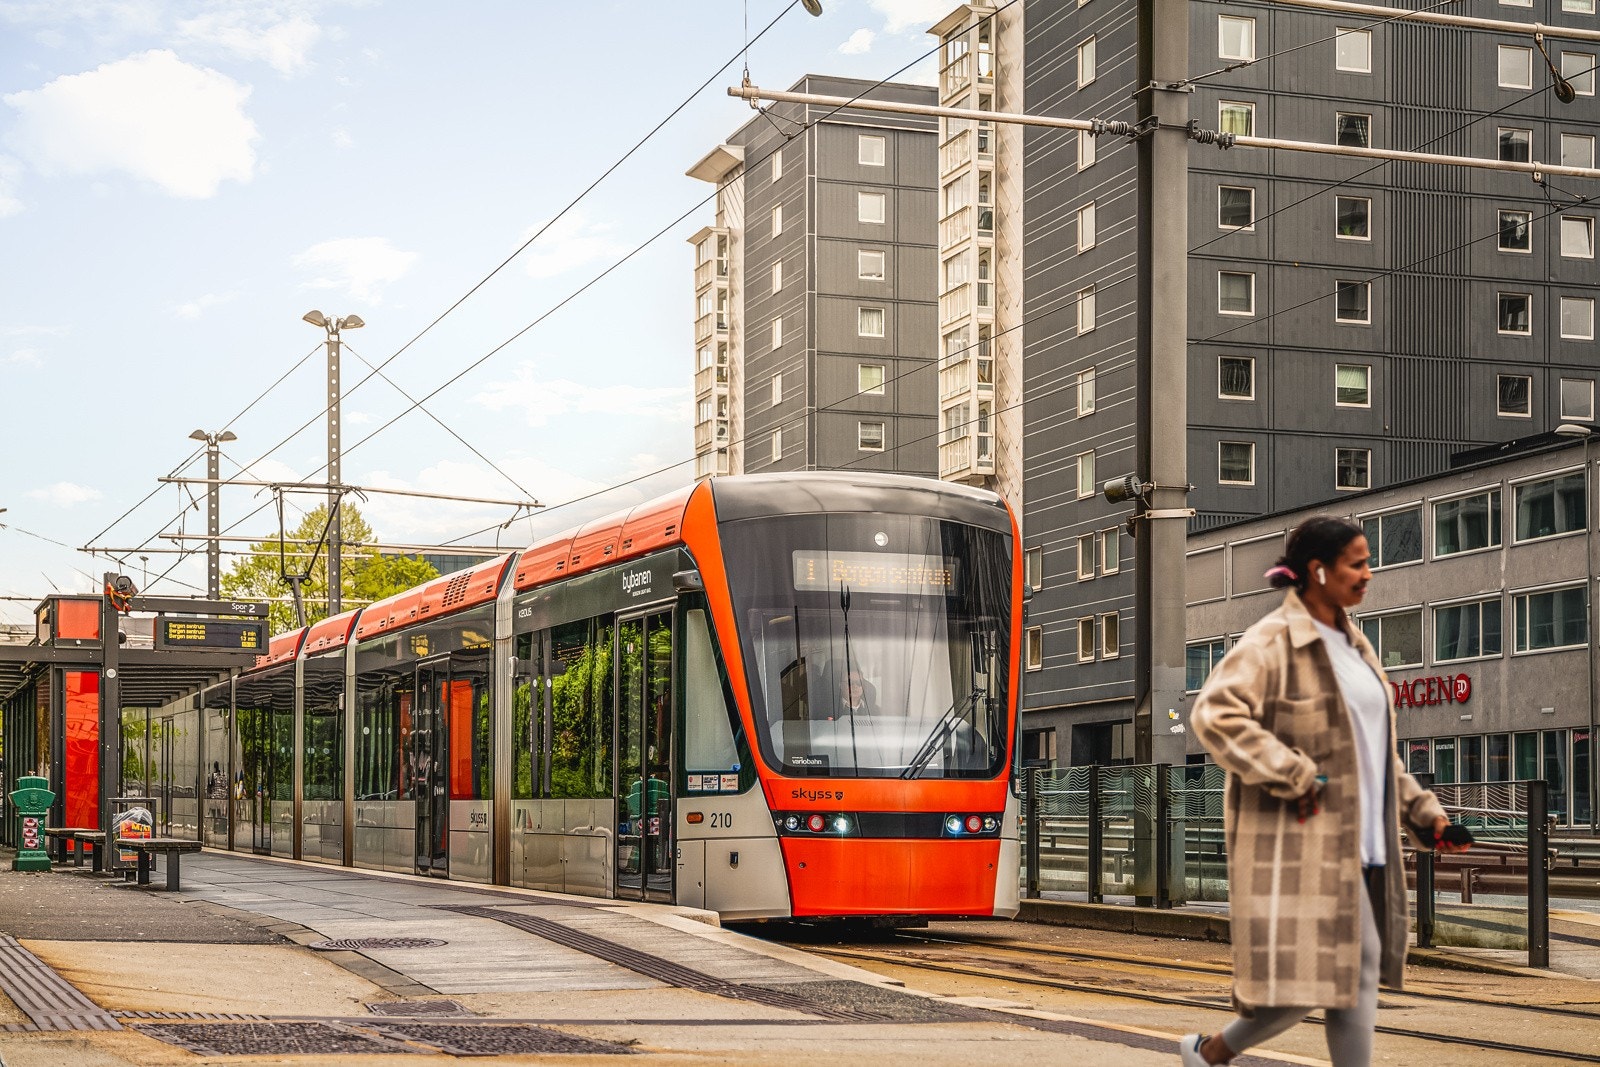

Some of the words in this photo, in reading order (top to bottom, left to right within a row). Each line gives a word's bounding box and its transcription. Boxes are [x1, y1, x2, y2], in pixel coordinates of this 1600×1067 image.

[622, 570, 652, 593] bybanen
[231, 603, 248, 611] Spor
[248, 604, 256, 613] 2
[792, 757, 822, 765] variobahn
[791, 787, 832, 802] skyss
[710, 813, 732, 828] 210
